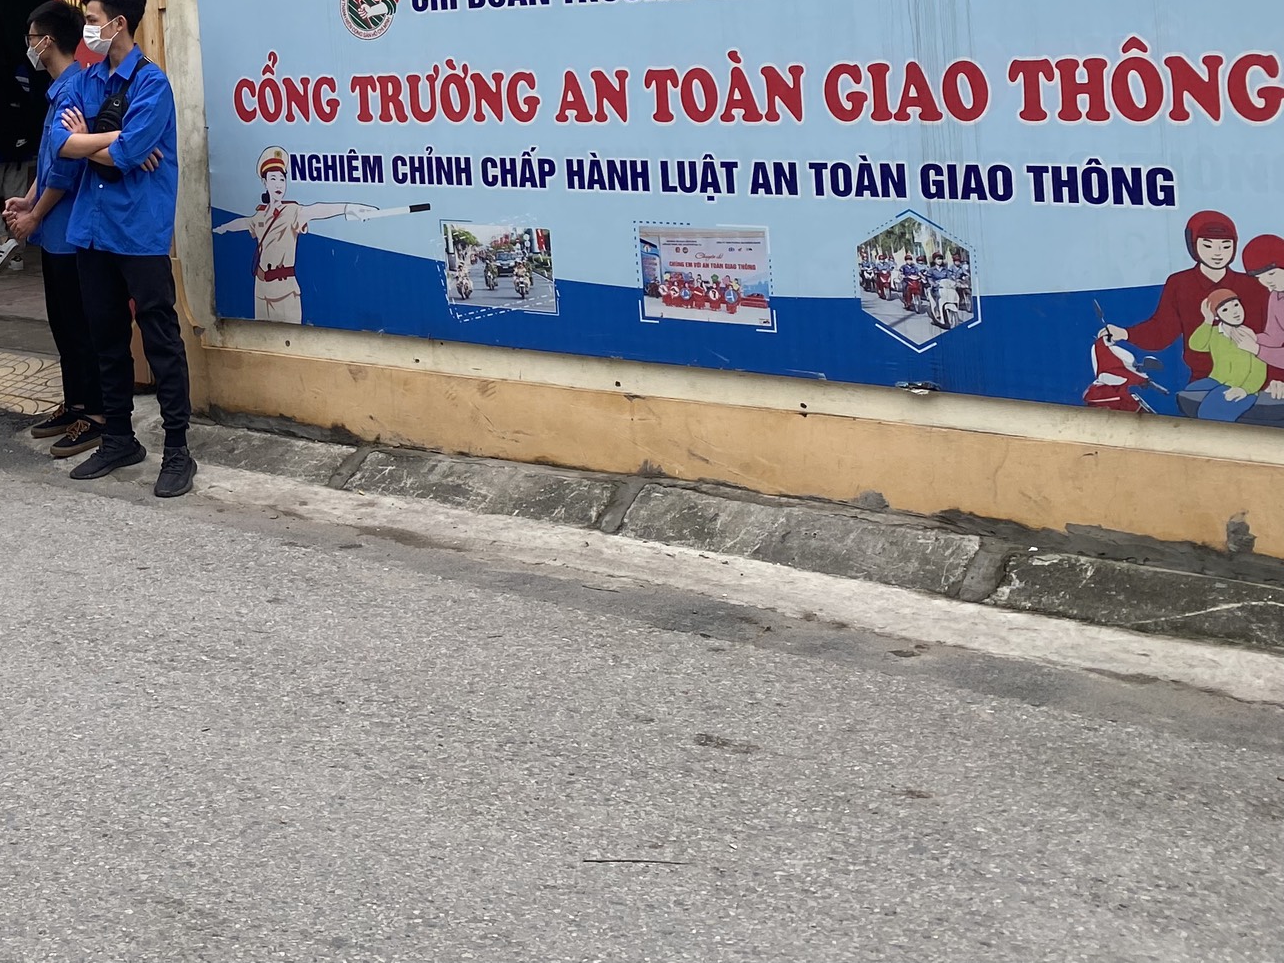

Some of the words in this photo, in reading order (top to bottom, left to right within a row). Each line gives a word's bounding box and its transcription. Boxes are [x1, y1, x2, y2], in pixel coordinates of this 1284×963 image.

[235, 50, 339, 123] CỔNG
[351, 58, 541, 123] TRƯỜNG
[556, 70, 629, 123] AN
[645, 51, 803, 123] TOÀN
[825, 60, 989, 122] GIAO
[1009, 38, 1284, 121] THÔNG
[289, 148, 384, 184] NGHIÊM
[391, 146, 473, 186] CHỈNH
[481, 151, 556, 189] CHẤP
[565, 152, 651, 192] HÀNH
[660, 153, 739, 201] LUẬT
[750, 161, 799, 196] AN
[808, 155, 907, 198] TOÀN
[920, 163, 1013, 202] GIAO
[1026, 158, 1176, 207] THÔNG
